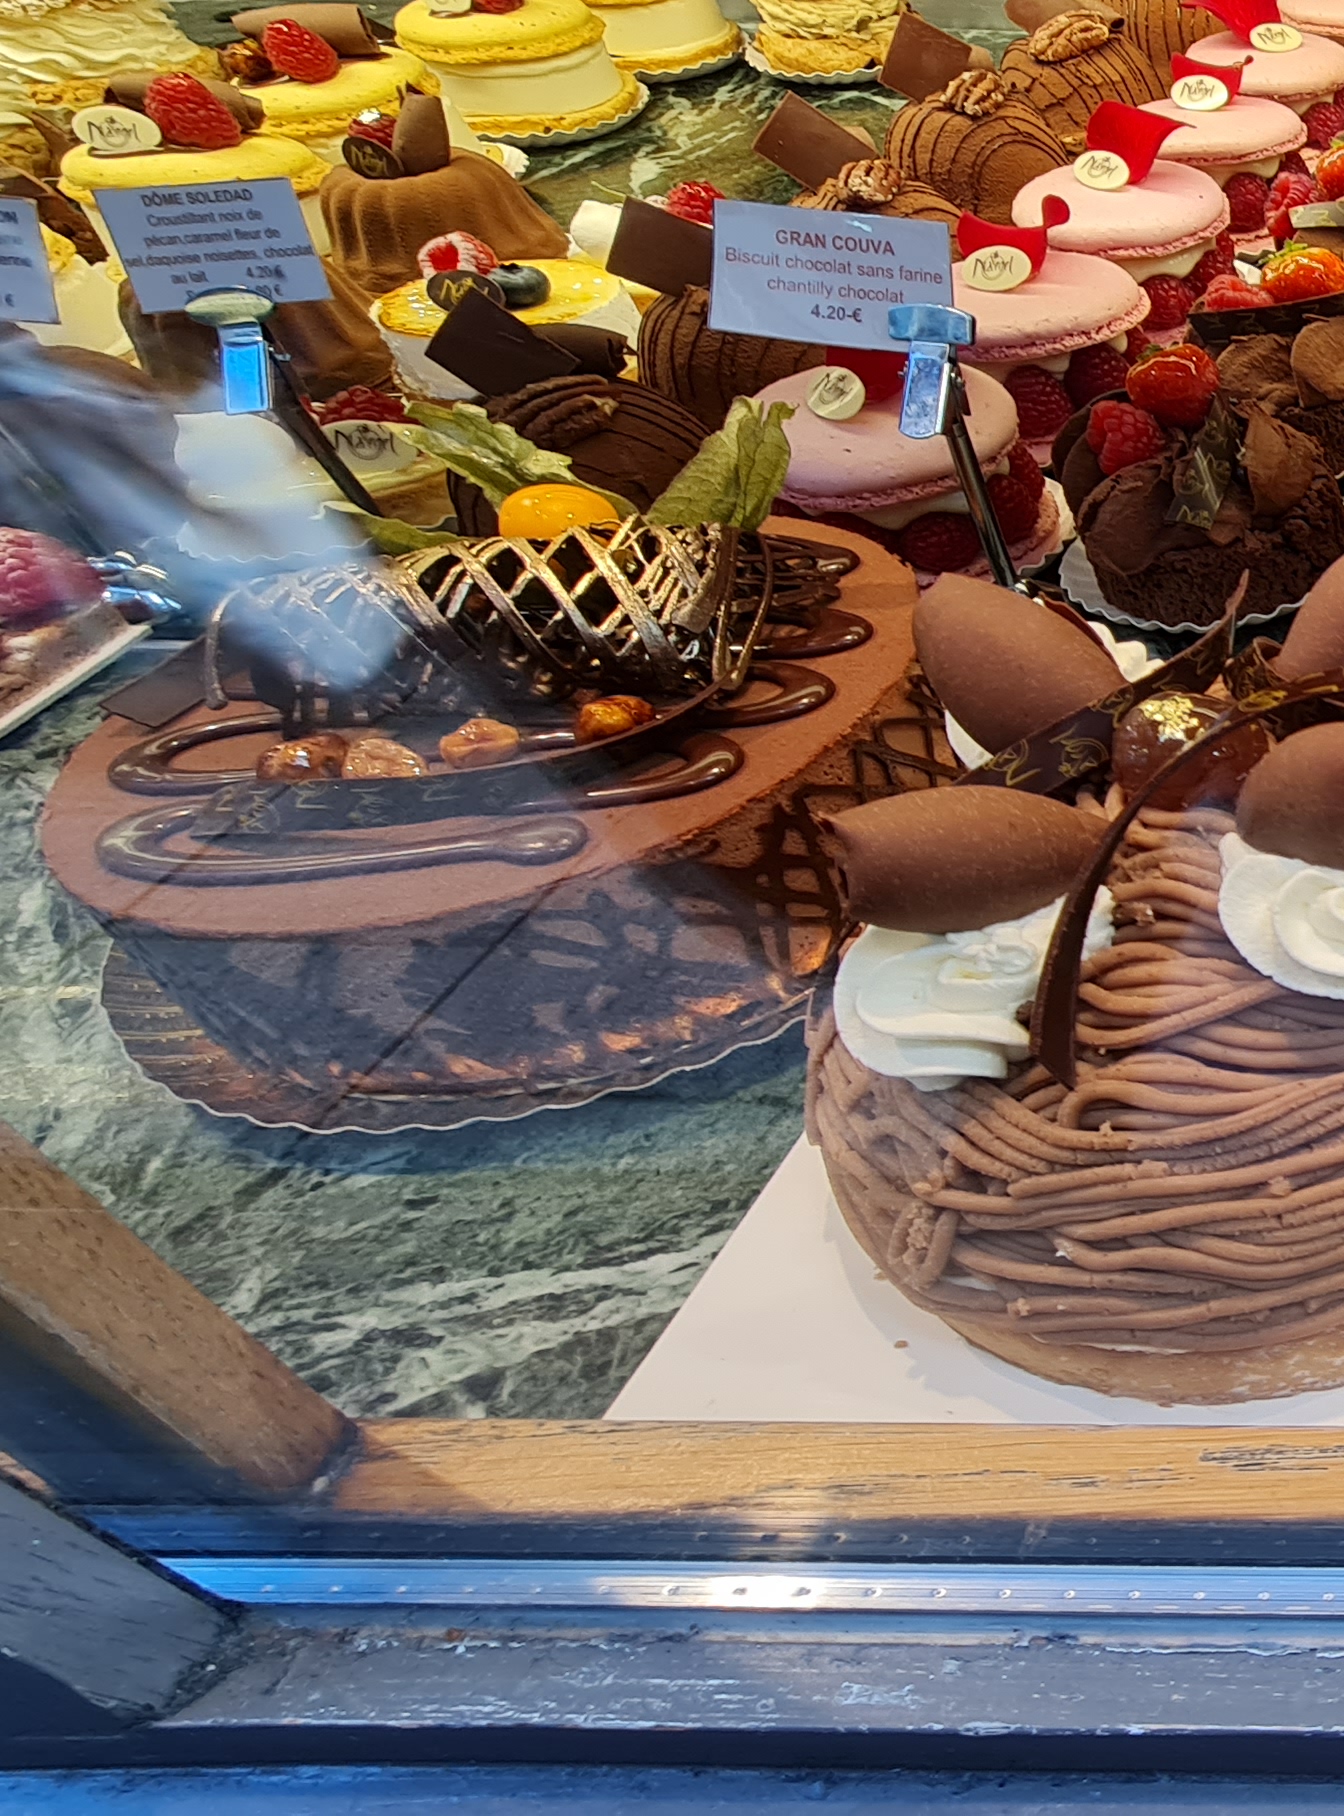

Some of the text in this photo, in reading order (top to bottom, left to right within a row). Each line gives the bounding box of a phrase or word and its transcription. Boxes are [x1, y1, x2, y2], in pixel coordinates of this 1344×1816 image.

[140, 189, 253, 208] DÔME SOLEDAD
[219, 211, 244, 222] noix
[247, 209, 263, 220] de
[236, 228, 262, 240] fleur
[264, 228, 281, 240] de
[775, 229, 895, 256] GRAN COUVA
[725, 247, 943, 284] Biscuit chocolat sans farine
[767, 276, 904, 304] chantilly chocolat
